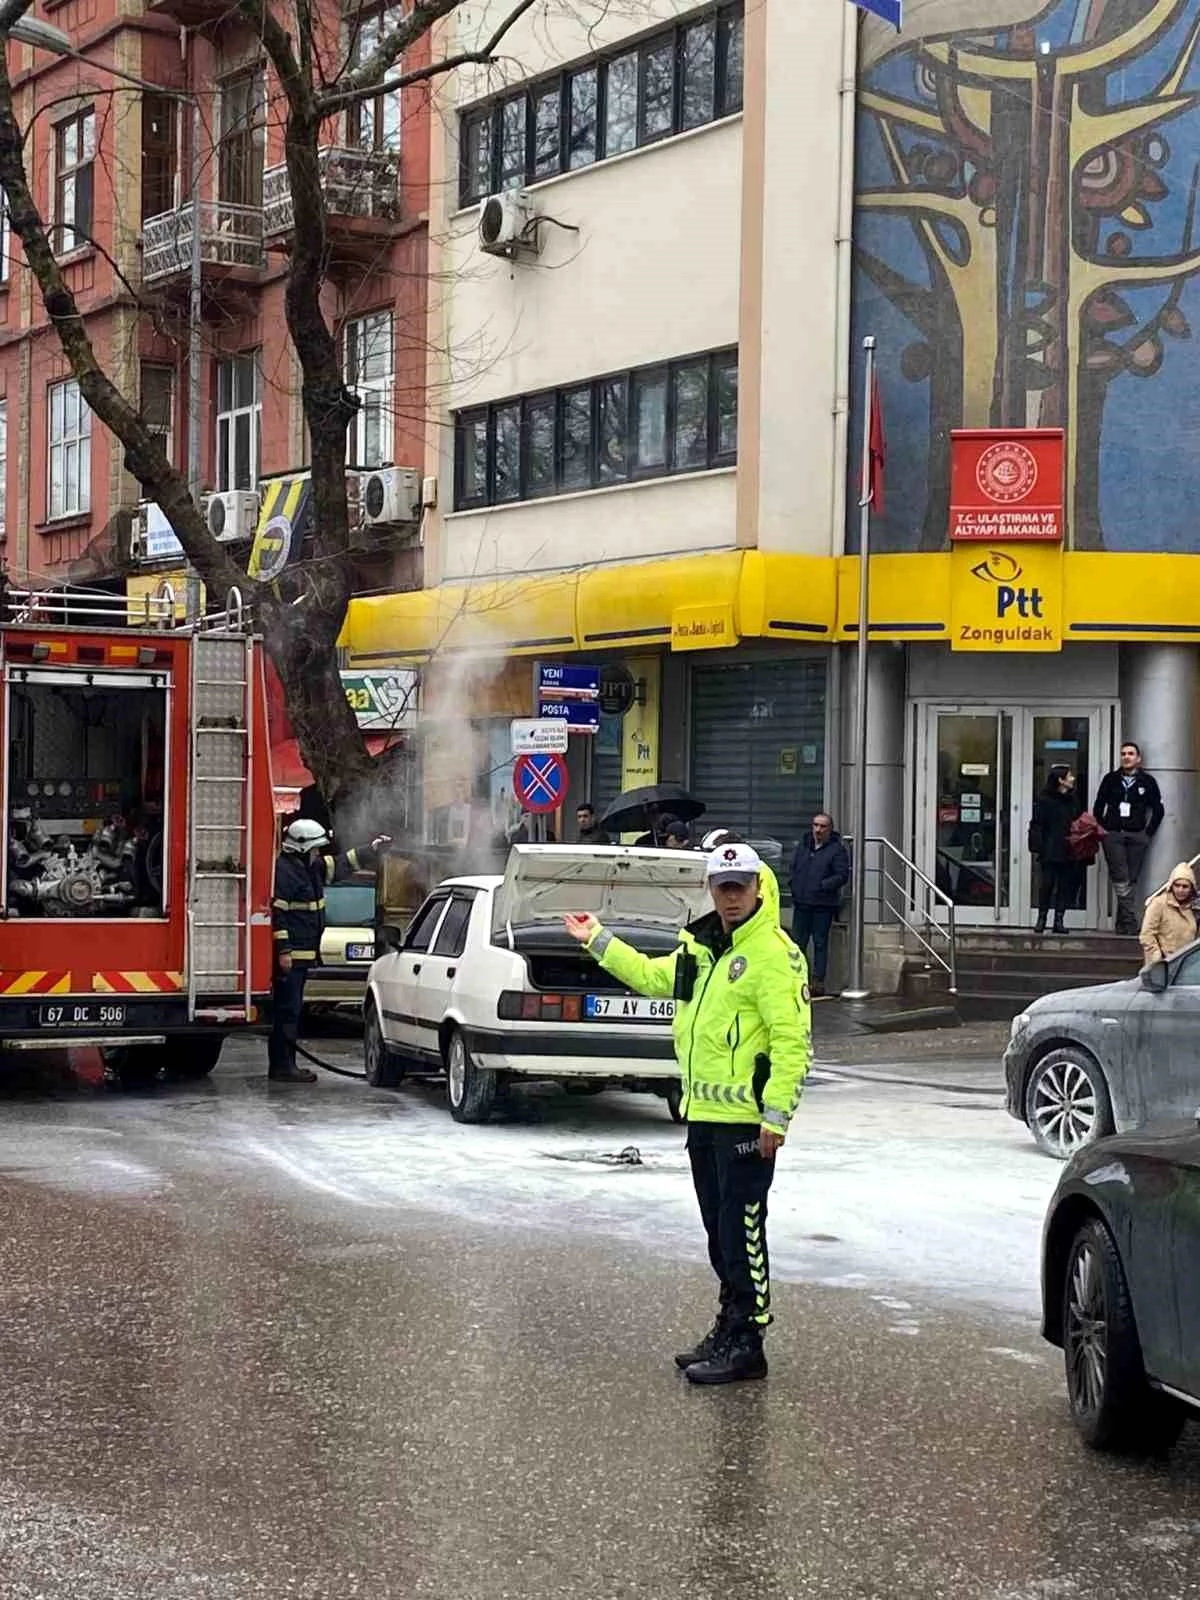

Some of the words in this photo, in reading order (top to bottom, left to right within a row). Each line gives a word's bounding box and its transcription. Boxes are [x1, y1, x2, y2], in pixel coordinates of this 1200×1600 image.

[957, 514, 976, 524] T.C.
[977, 513, 1037, 526] ULAŞTIRMA
[1039, 513, 1055, 523] VE
[954, 525, 998, 536] ALTYAPI
[999, 524, 1057, 535] BAKANLIĞI
[997, 585, 1043, 618] Ptt
[960, 625, 1053, 644] Zonguldak
[542, 667, 564, 679] YENİ
[542, 704, 570, 716] POSTA
[47, 1007, 64, 1021] 67
[73, 1007, 89, 1021] DC
[100, 1007, 123, 1021] 506
[595, 999, 610, 1014] 67
[649, 1002, 674, 1017] 646
